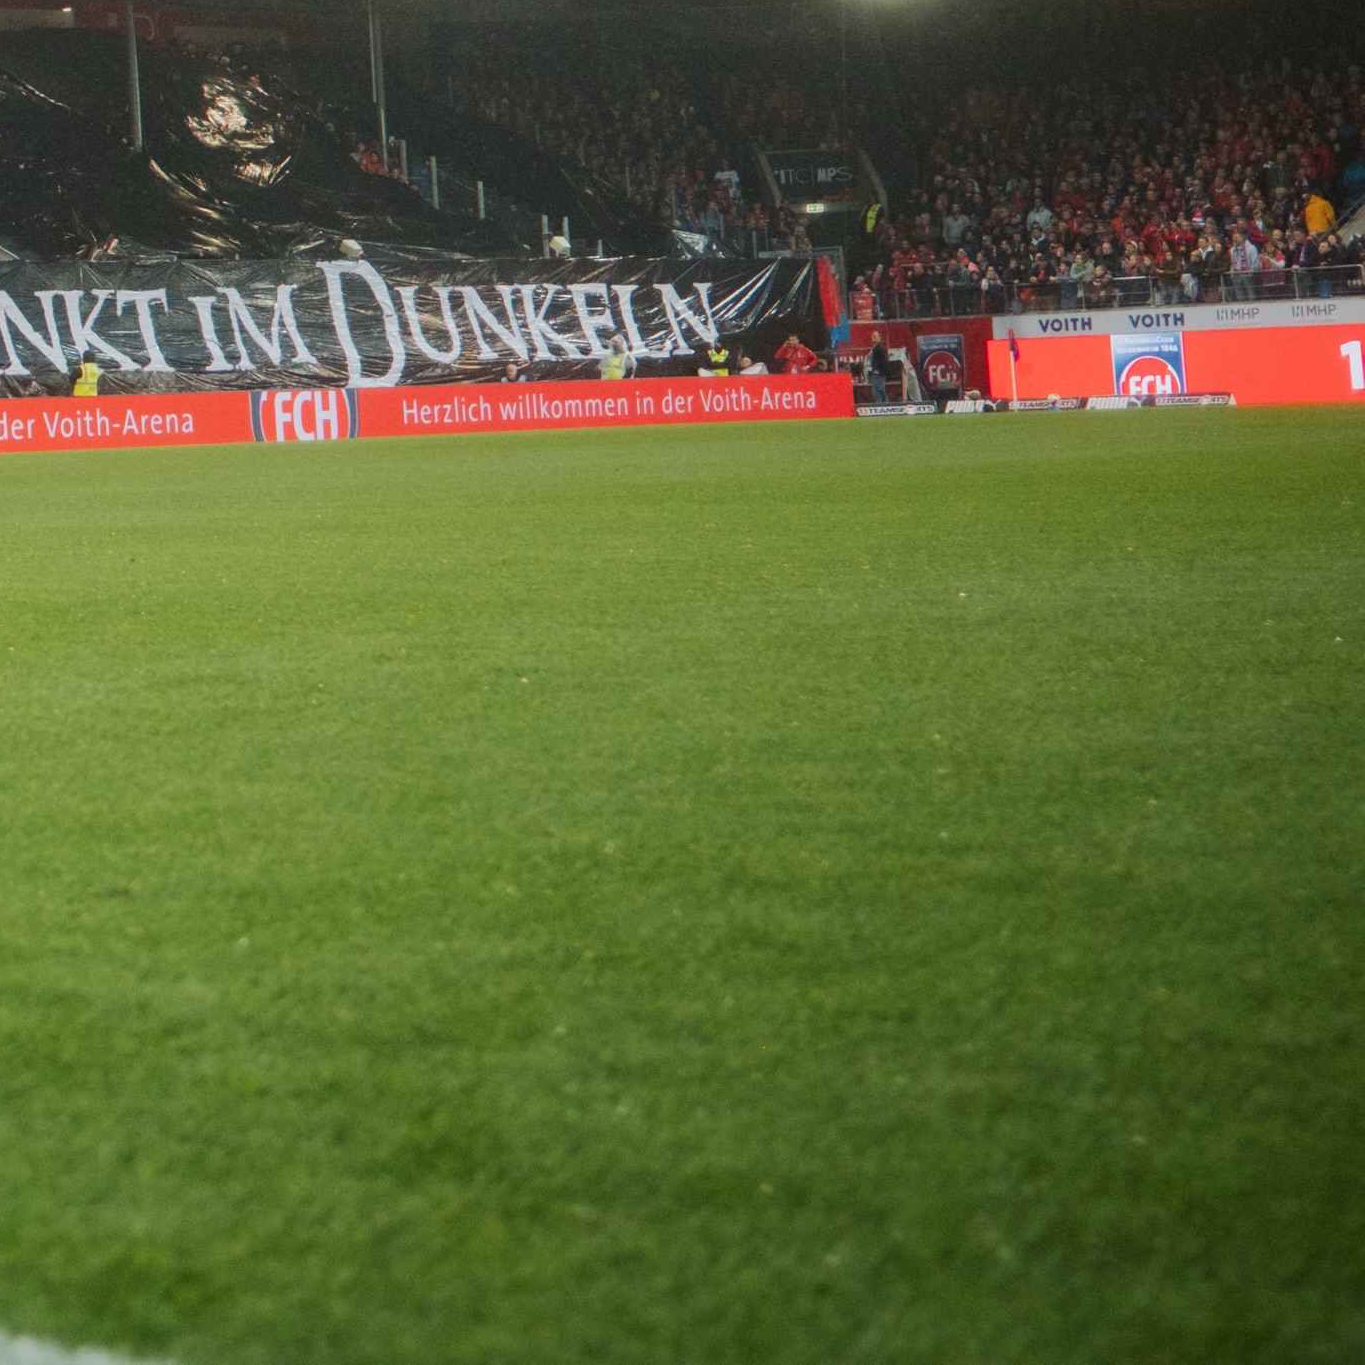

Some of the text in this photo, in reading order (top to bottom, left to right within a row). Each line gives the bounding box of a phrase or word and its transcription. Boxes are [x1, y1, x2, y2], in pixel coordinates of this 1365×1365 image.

[1039, 312, 1185, 332] VOITH VOITH
[1231, 307, 1260, 320] MHP
[1307, 304, 1336, 317] MHP
[188, 285, 319, 373] IM
[316, 260, 721, 388] DUNKELN
[273, 389, 339, 442] FCH
[402, 383, 816, 425] Herzlich willkommen in der Voith-Arena
[1086, 396, 1129, 410] PUMA
[43, 408, 194, 439] Voith-Arena
